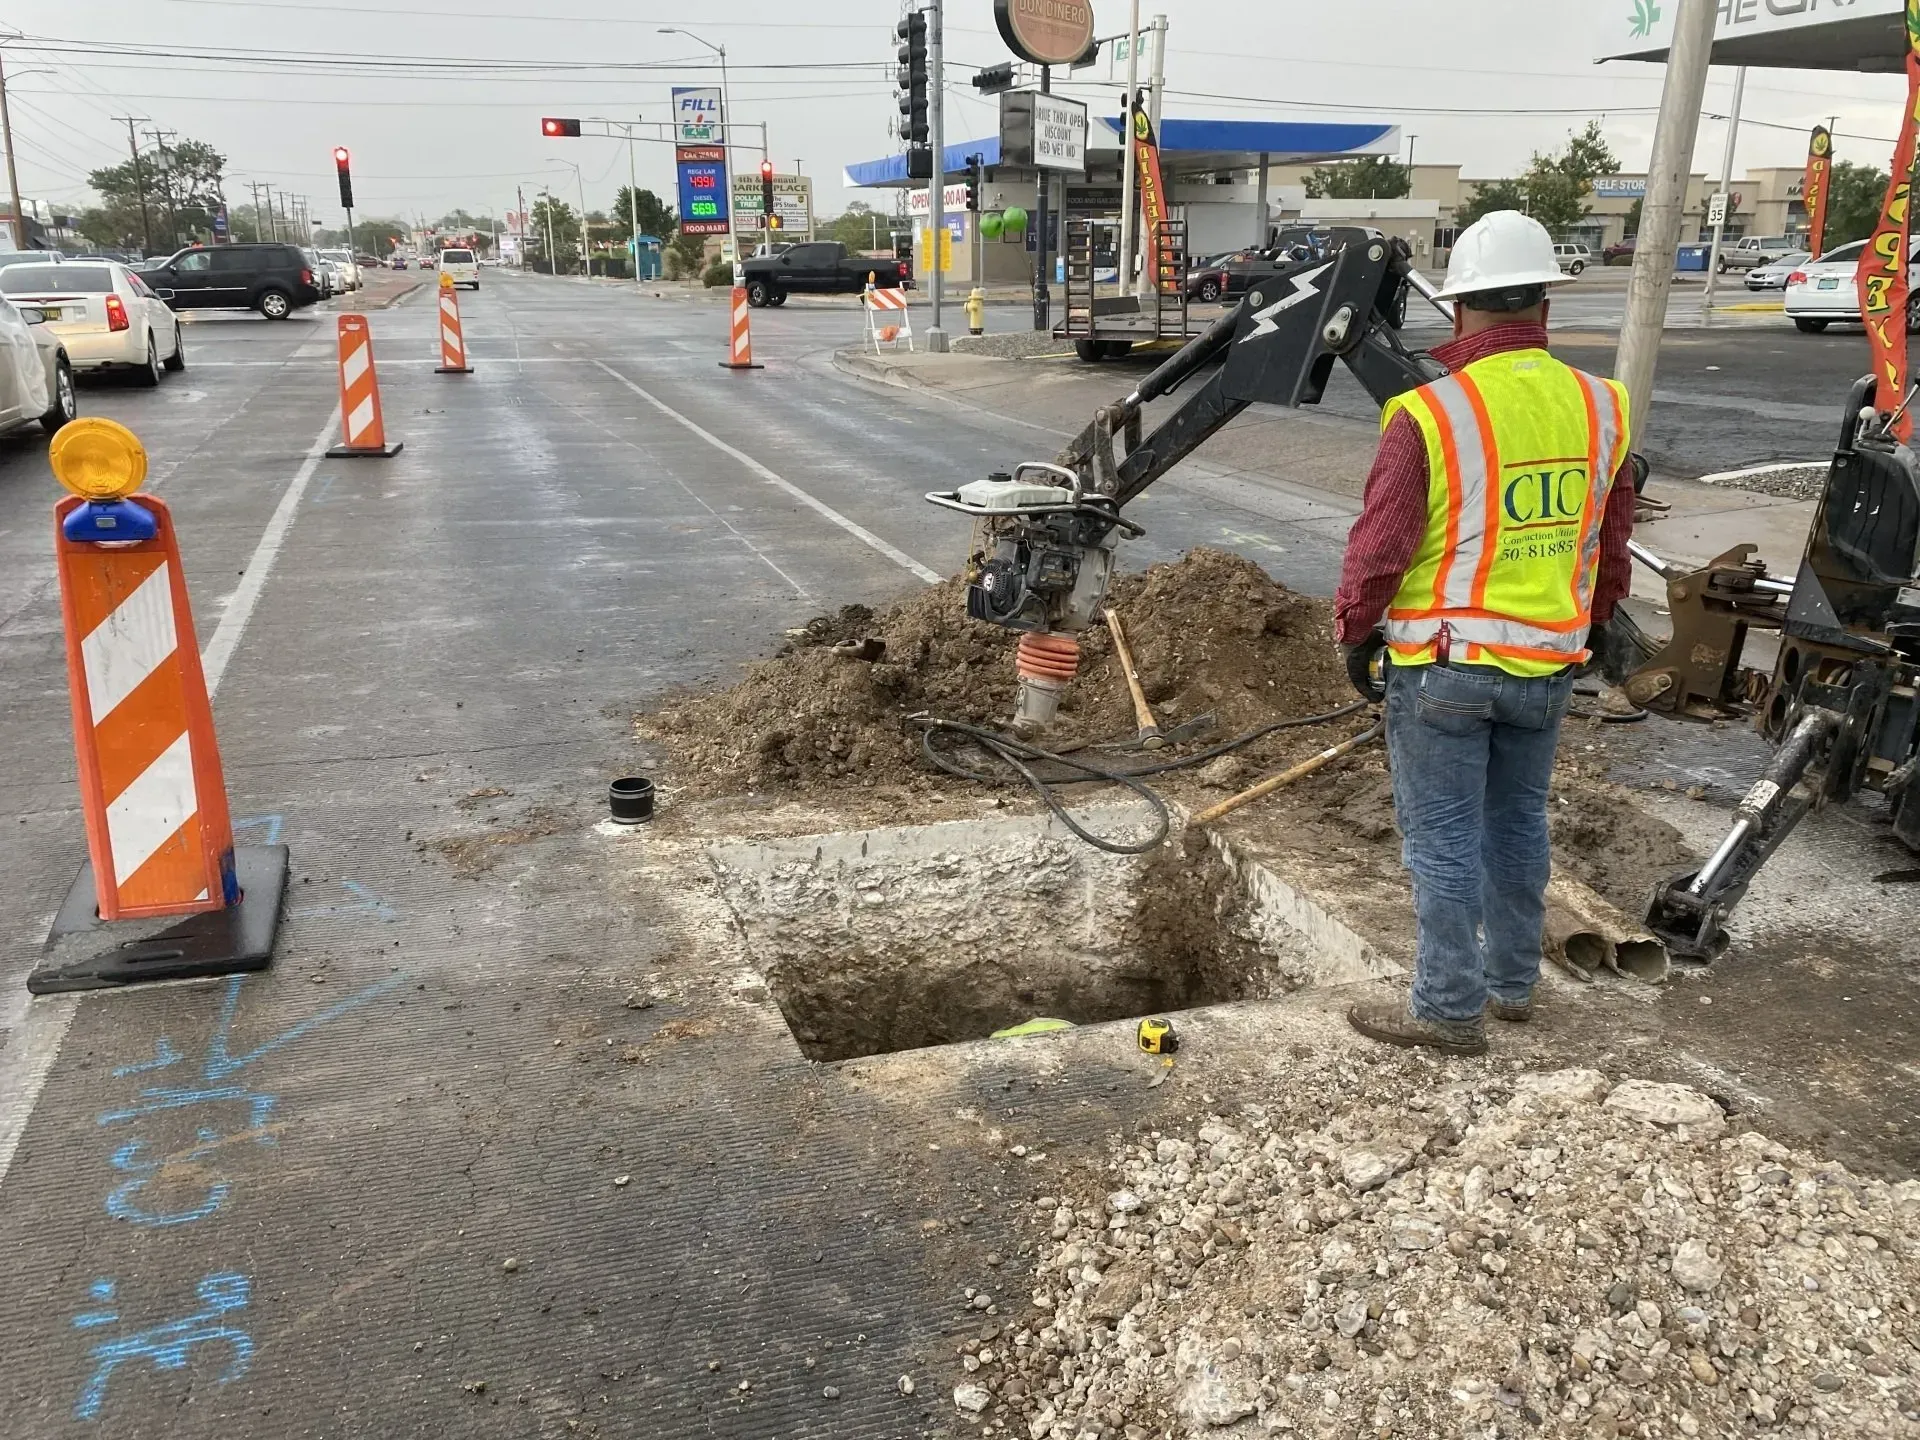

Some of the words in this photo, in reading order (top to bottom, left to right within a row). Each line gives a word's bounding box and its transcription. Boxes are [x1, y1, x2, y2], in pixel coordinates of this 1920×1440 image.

[1046, 0, 1085, 24] DINERO
[681, 98, 716, 111] FILL
[1069, 112, 1084, 127] OPEN
[1044, 125, 1072, 142] DISCOUNT
[738, 175, 753, 184] 4th
[1592, 179, 1617, 190] SELF
[1619, 179, 1646, 190] STOR
[733, 184, 808, 192] ARKPLACE
[912, 194, 930, 209] OPEN
[1710, 209, 1724, 221] 35
[686, 225, 705, 233] FOOD
[706, 224, 726, 232] MART
[1504, 468, 1586, 523] CIC
